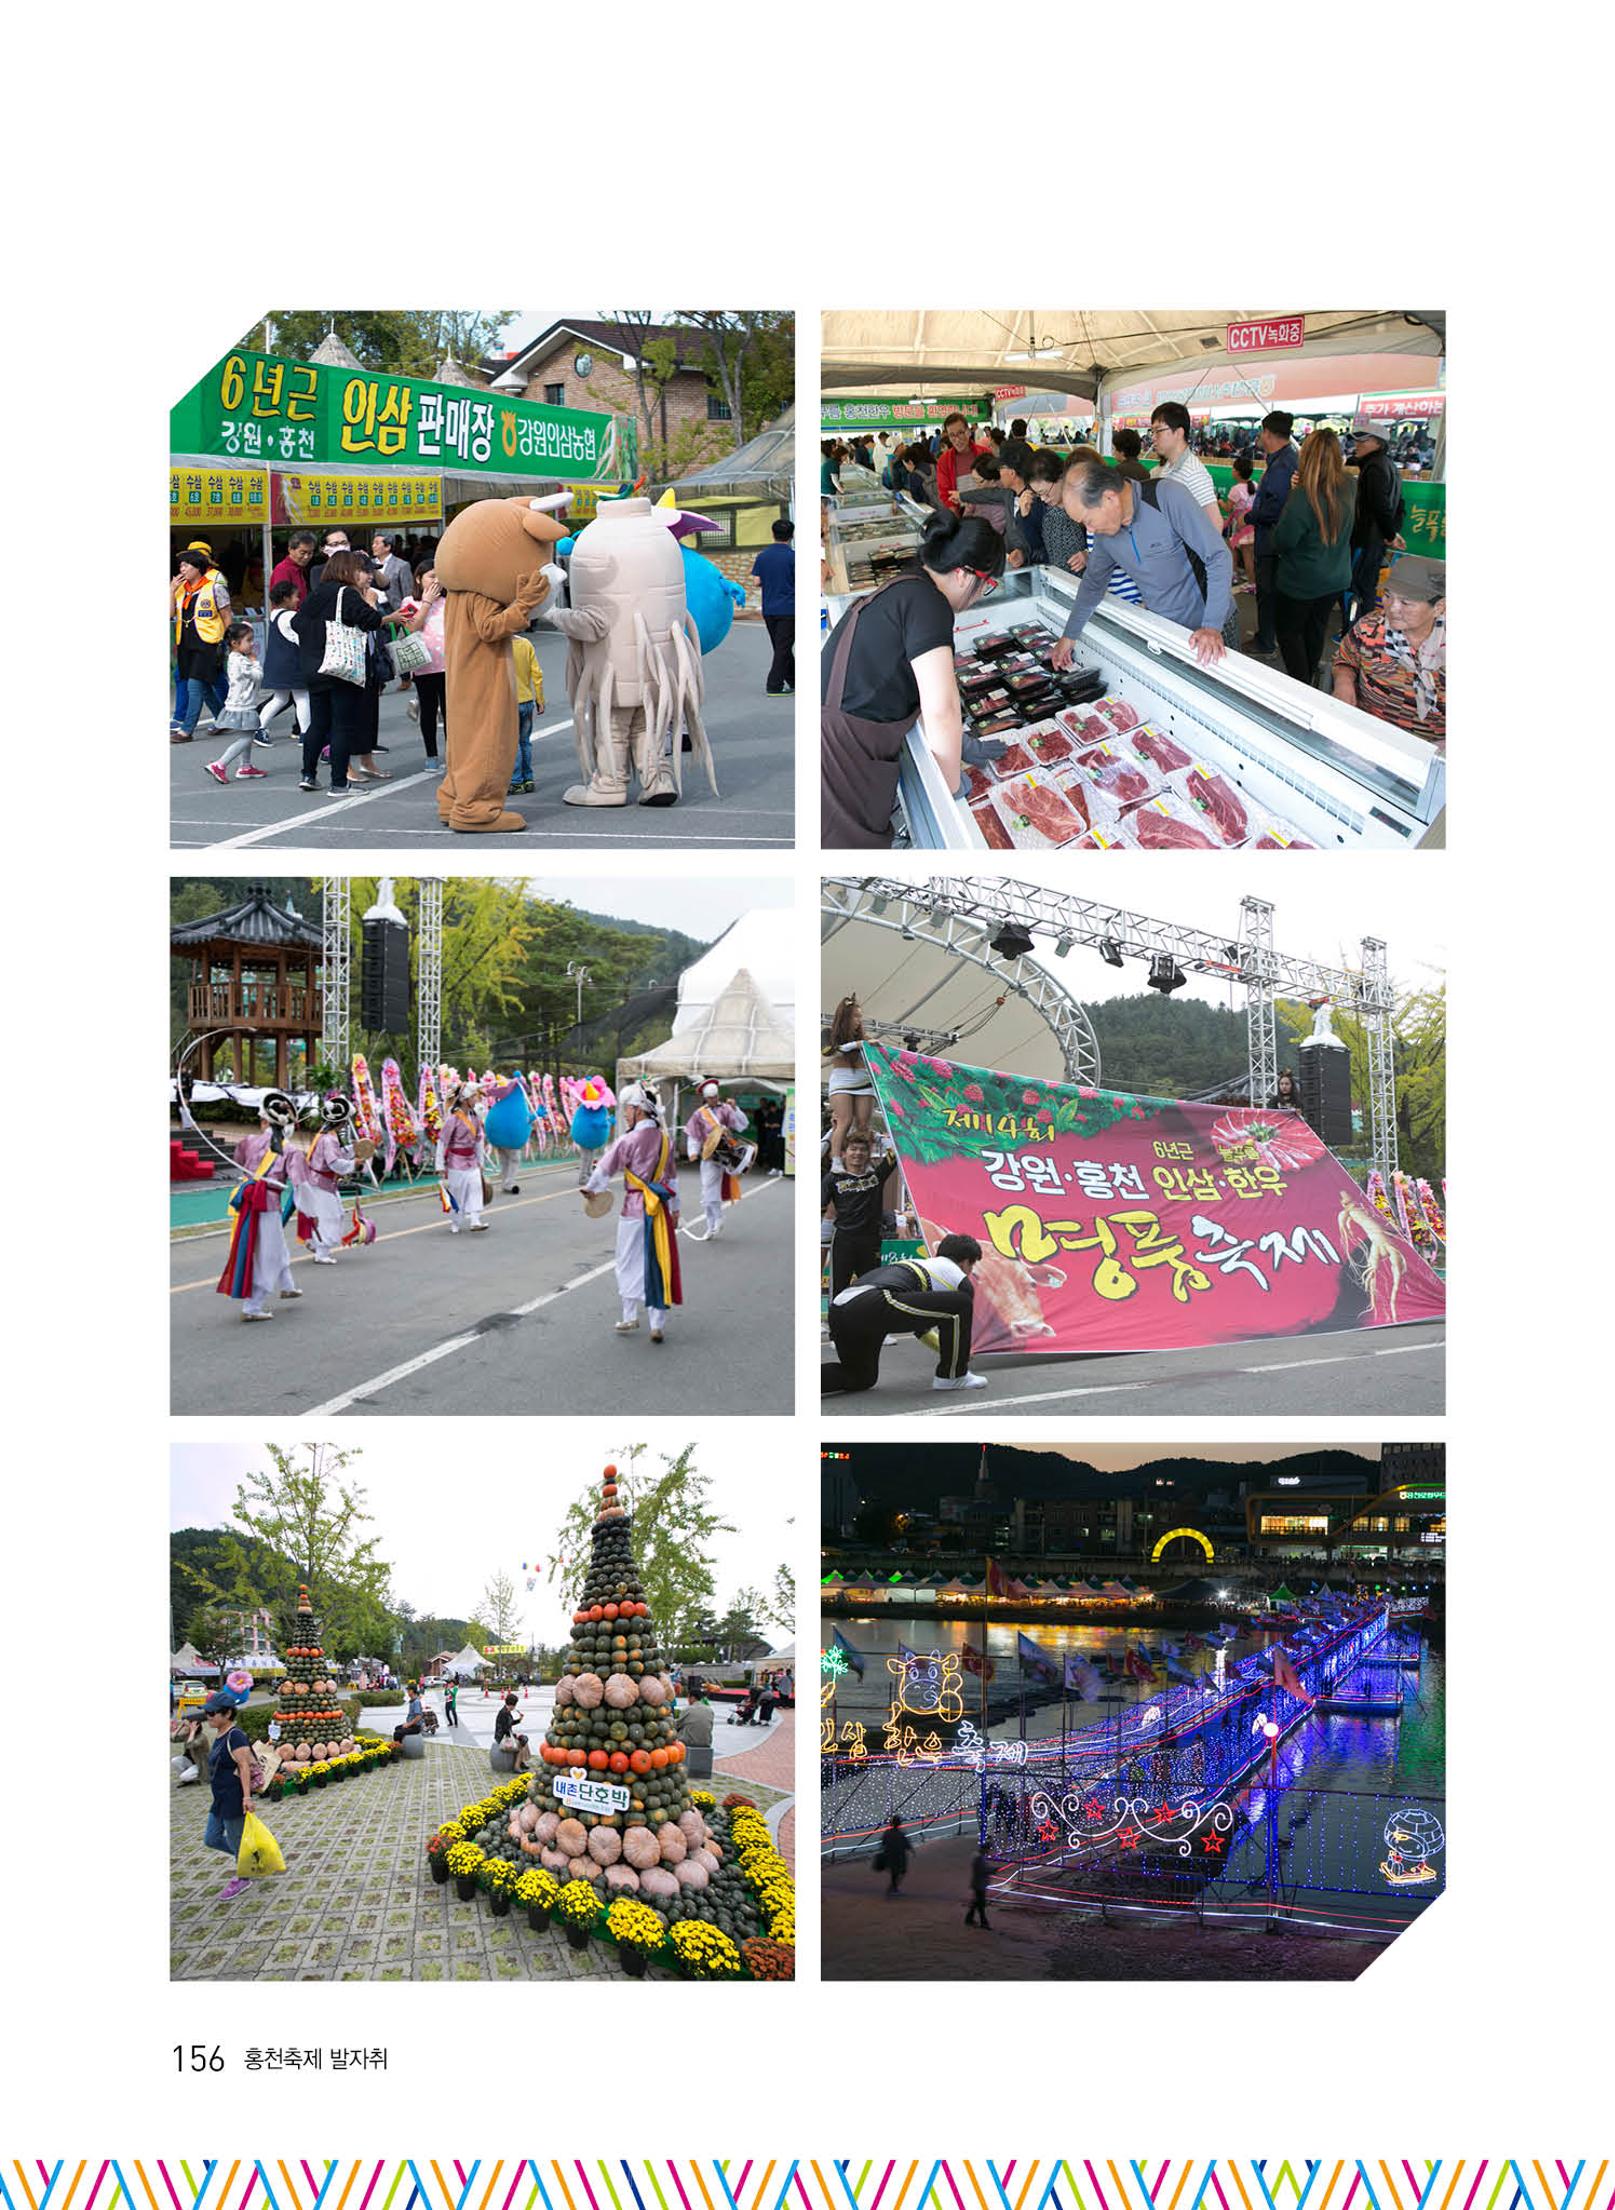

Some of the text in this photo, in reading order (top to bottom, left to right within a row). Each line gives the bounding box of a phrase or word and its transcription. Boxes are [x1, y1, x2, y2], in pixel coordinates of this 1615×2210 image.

[1230, 323, 1301, 349] CCTV녹화중
[221, 355, 597, 463] 6년근 인삼 판매장 강원인삼농협
[186, 474, 202, 491] 수삼
[208, 475, 223, 491] 수삼
[942, 1108, 1056, 1142] 제14회
[1152, 1141, 1195, 1162] 6년근
[952, 1720, 1029, 1772] 축제
